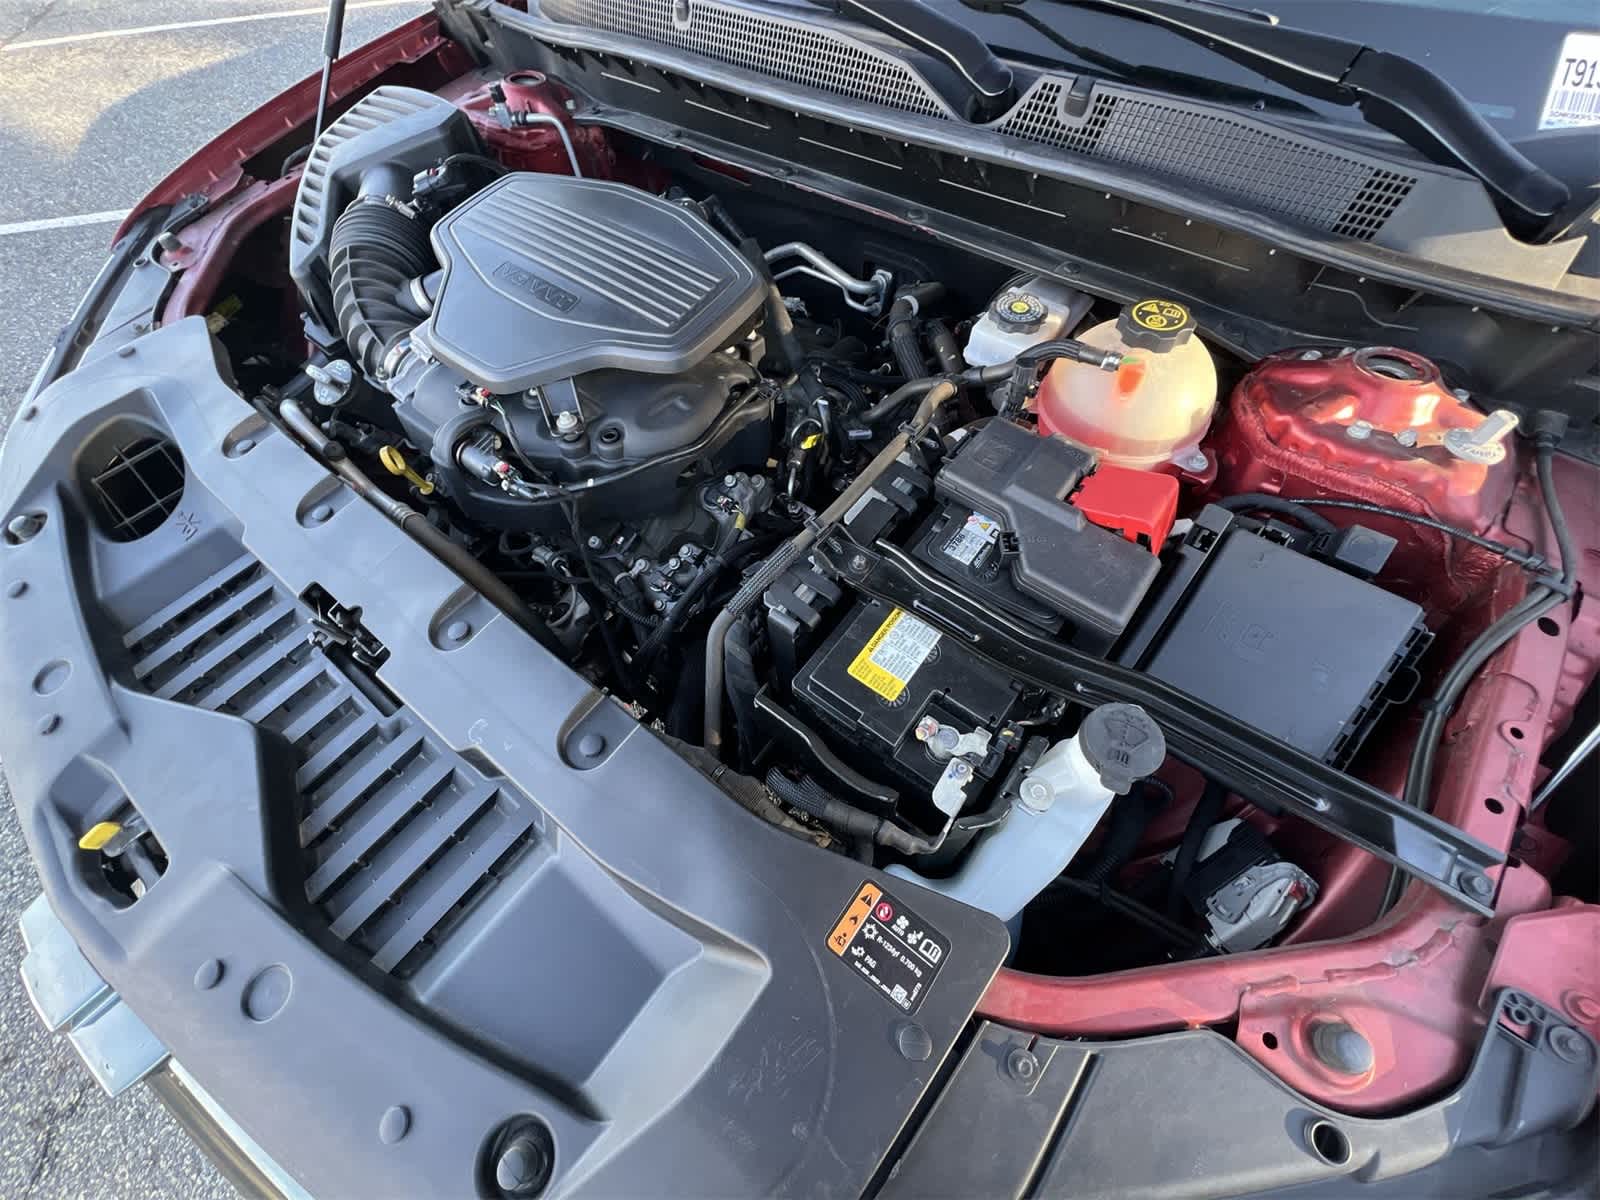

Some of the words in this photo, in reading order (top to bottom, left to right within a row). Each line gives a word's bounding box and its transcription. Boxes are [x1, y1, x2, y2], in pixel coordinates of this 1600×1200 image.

[864, 954, 877, 969] PAG
[877, 935, 900, 957] R-1234yf
[900, 955, 915, 971] 0.700
